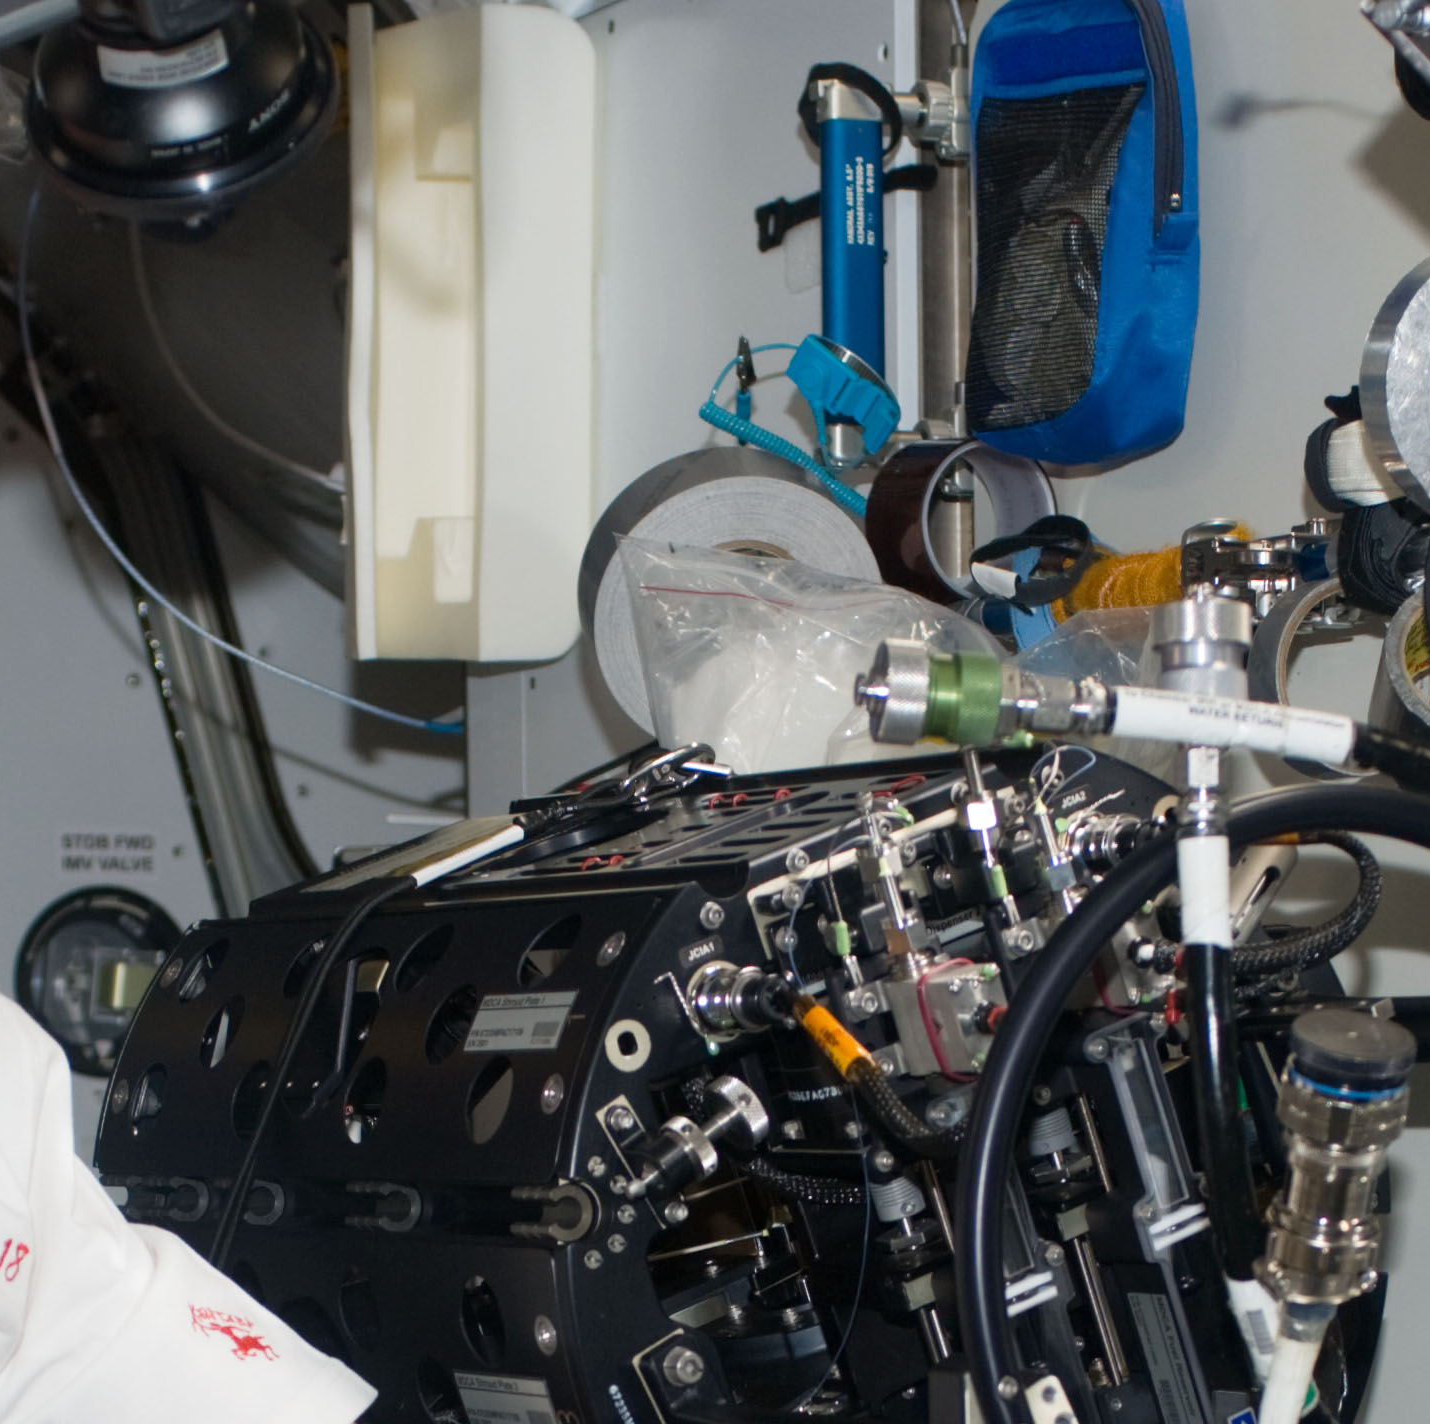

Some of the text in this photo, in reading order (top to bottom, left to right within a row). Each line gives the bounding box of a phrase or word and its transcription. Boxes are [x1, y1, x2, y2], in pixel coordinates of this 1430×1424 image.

[248, 88, 291, 135] SONY
[1060, 790, 1087, 809] JCIA2
[98, 855, 154, 873] VALVE
[688, 940, 716, 963] JCIA1
